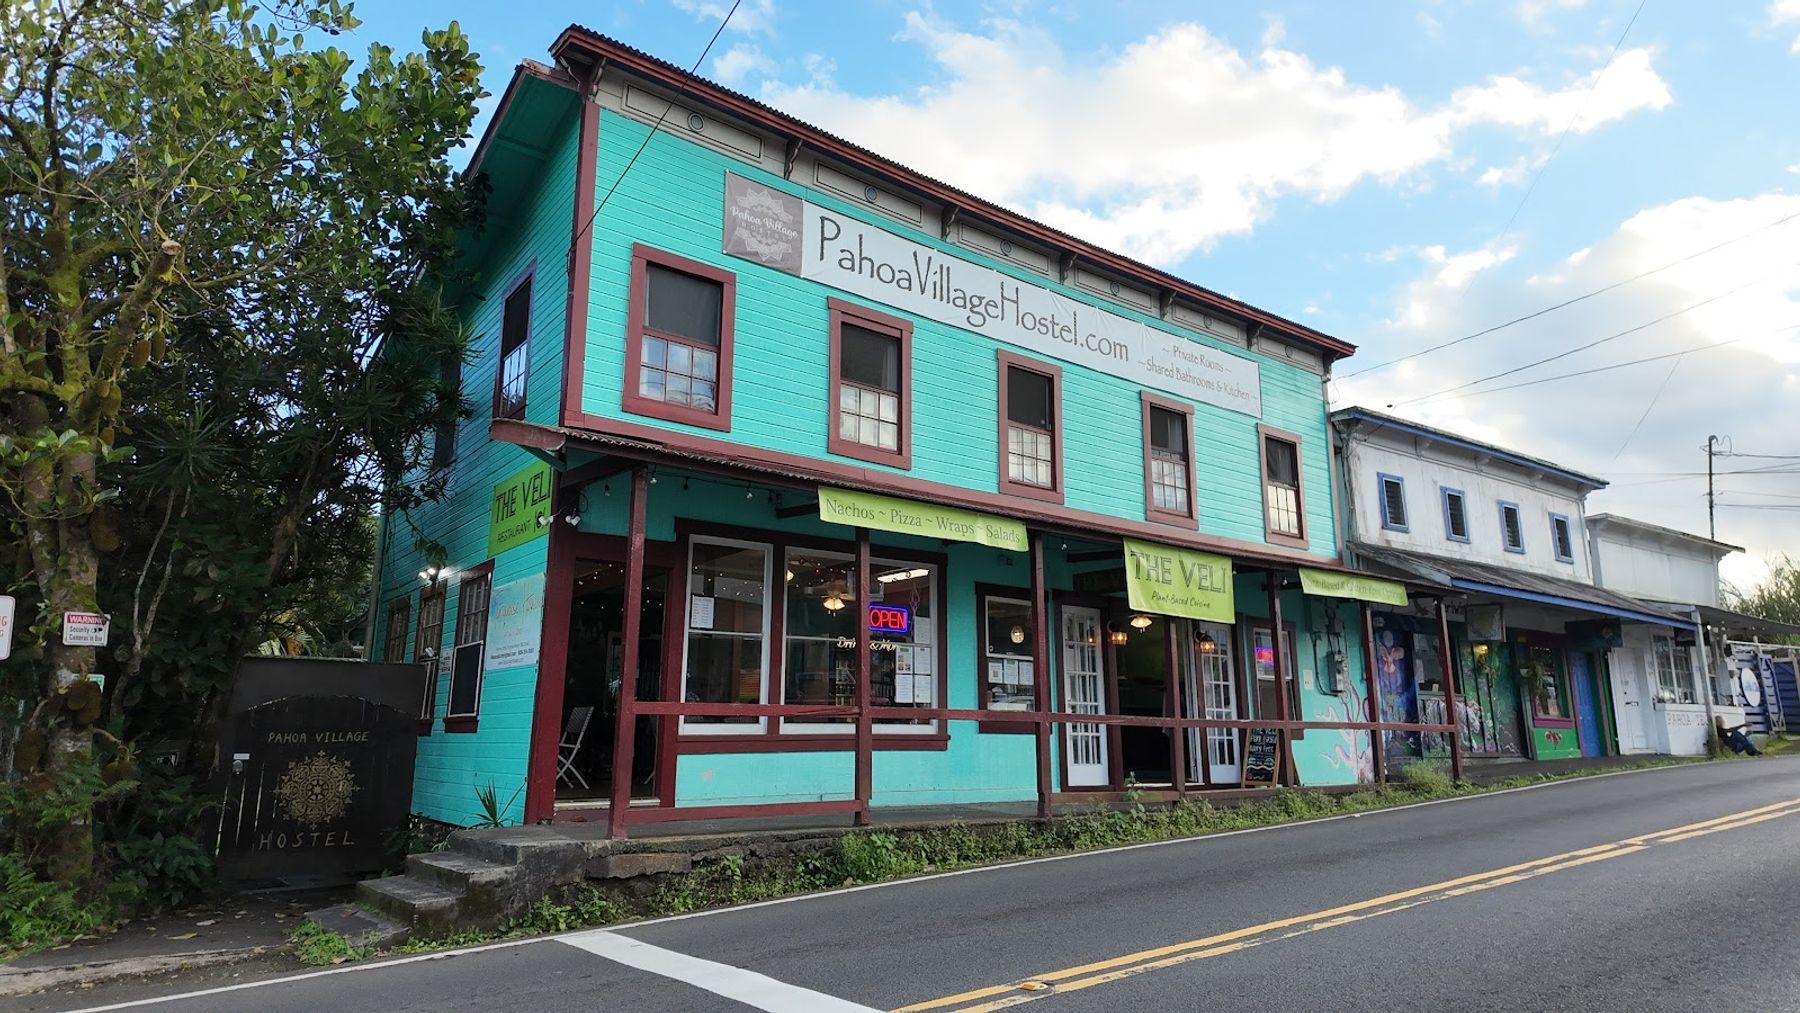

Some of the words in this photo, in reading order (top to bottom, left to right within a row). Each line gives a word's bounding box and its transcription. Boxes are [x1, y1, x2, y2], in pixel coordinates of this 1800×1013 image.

[729, 206, 762, 226] Pahoa
[763, 218, 798, 240] Village
[819, 215, 1129, 362] PahoaVillageHostel.com
[1173, 345, 1199, 365] Private
[1199, 355, 1224, 373] Rooms
[1175, 366, 1216, 390] Bathrooms
[1215, 380, 1223, 391] &
[1223, 382, 1250, 401] Kitchen
[495, 485, 518, 524] THE
[497, 519, 531, 544] RESTAURANT
[825, 498, 875, 520] Nachos
[890, 508, 922, 527] Pizza
[936, 516, 974, 537] Wraps
[985, 524, 1021, 544] Salads
[1130, 550, 1172, 585] THE
[1179, 559, 1226, 594] VELI
[1189, 597, 1211, 608] Cuisine
[69, 626, 89, 634] Security
[870, 610, 906, 629] OPEN
[879, 638, 897, 651] Mor
[267, 731, 307, 744] PAHOA
[315, 731, 370, 743] VILLAGE
[258, 831, 355, 850] HOSTEL
